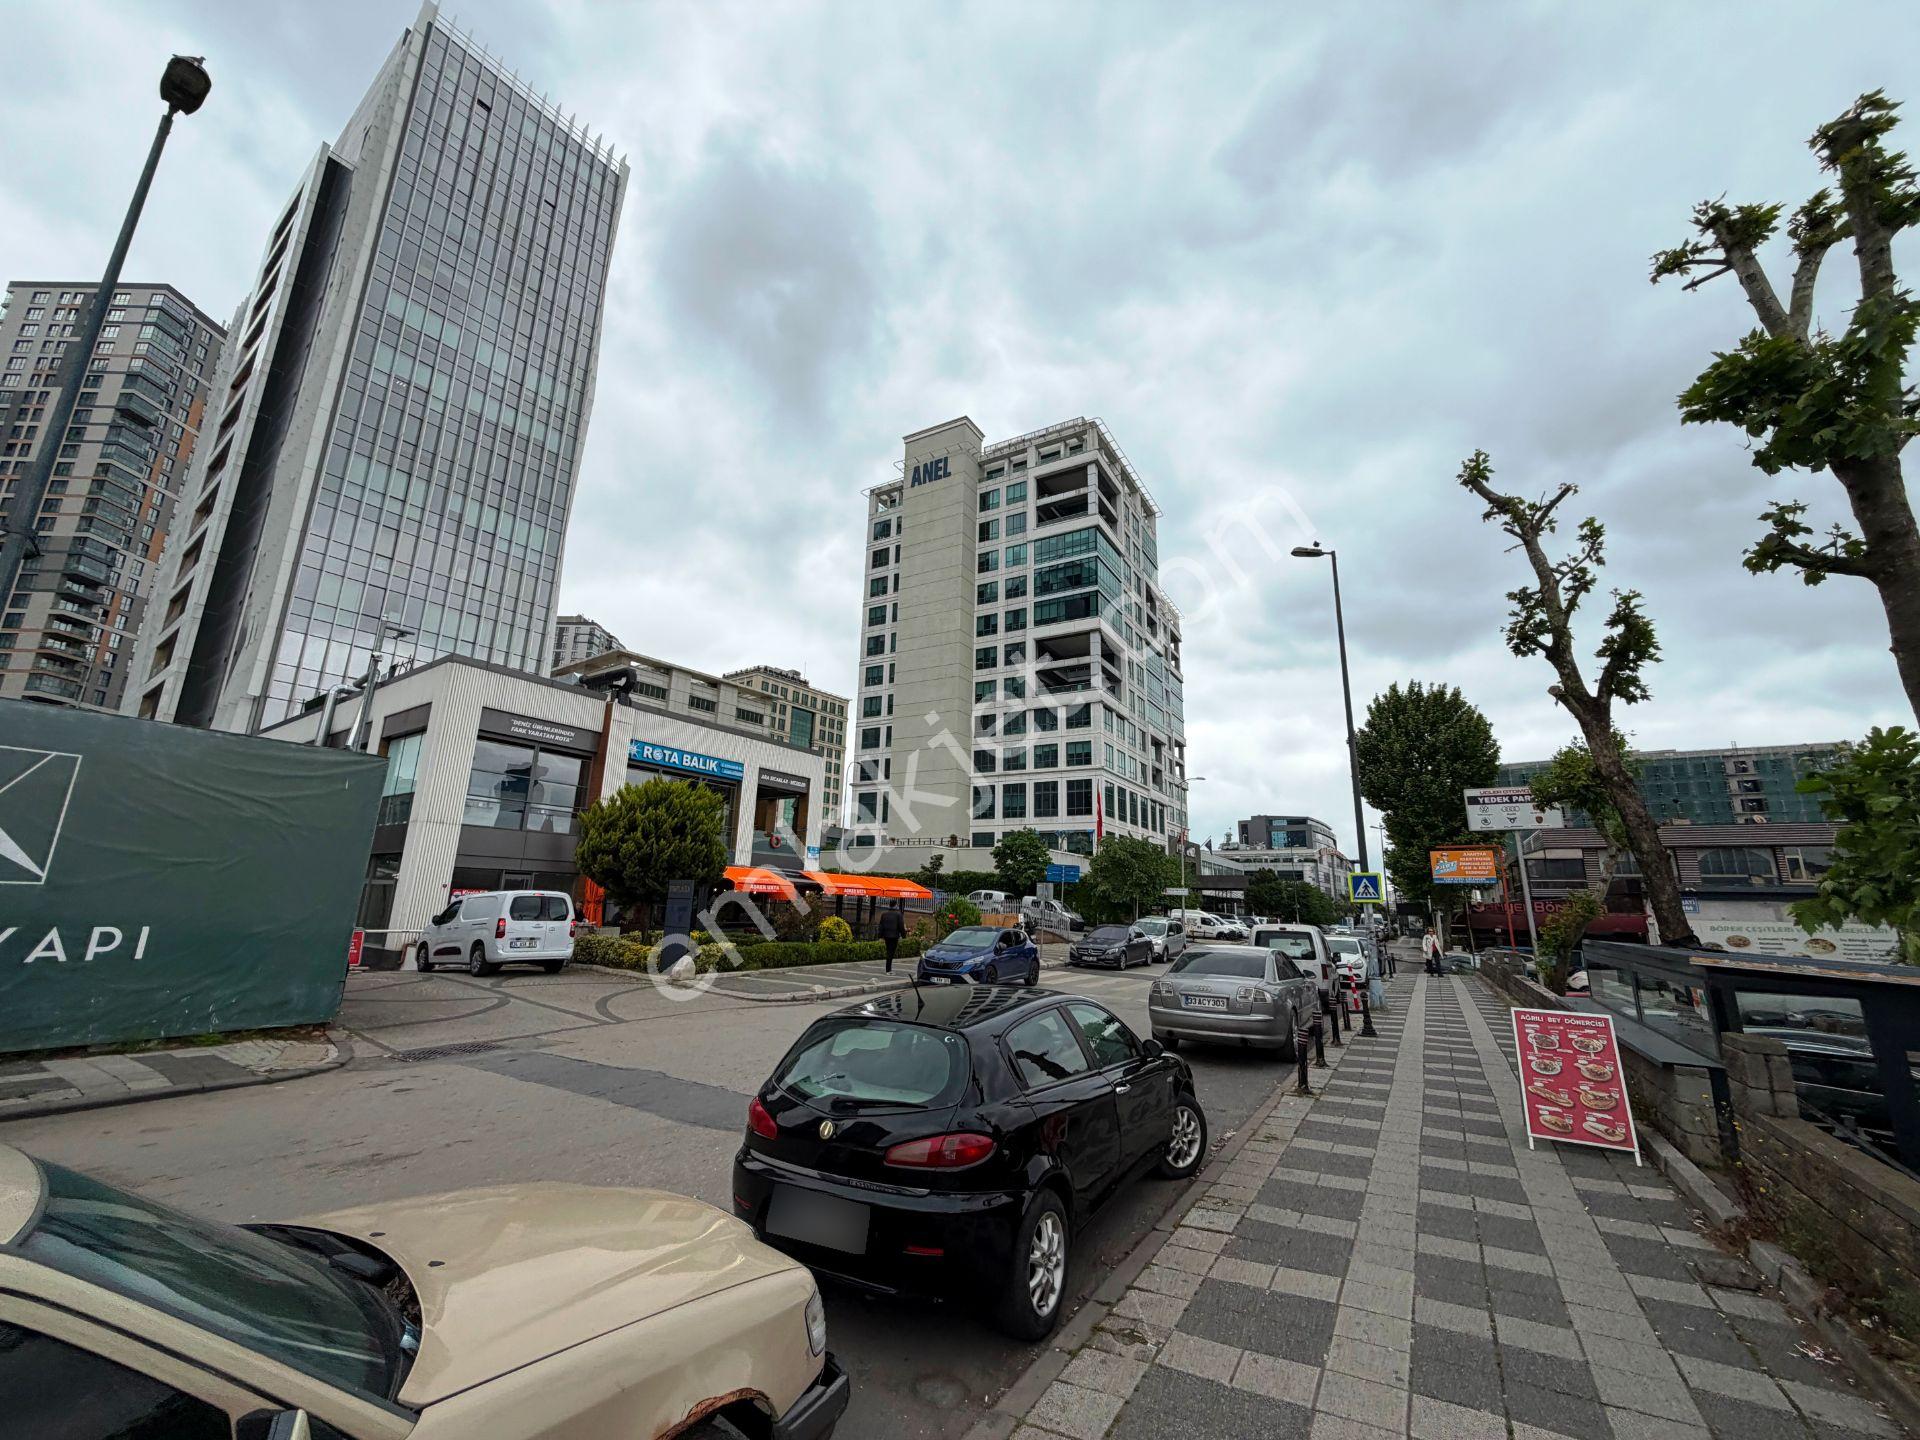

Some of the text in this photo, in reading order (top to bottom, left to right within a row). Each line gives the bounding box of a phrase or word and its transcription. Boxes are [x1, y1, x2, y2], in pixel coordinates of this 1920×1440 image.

[911, 456, 951, 488] ANEL
[643, 745, 679, 764] ROTA
[682, 754, 719, 772] BALIK
[1477, 796, 1510, 804] YEDEK
